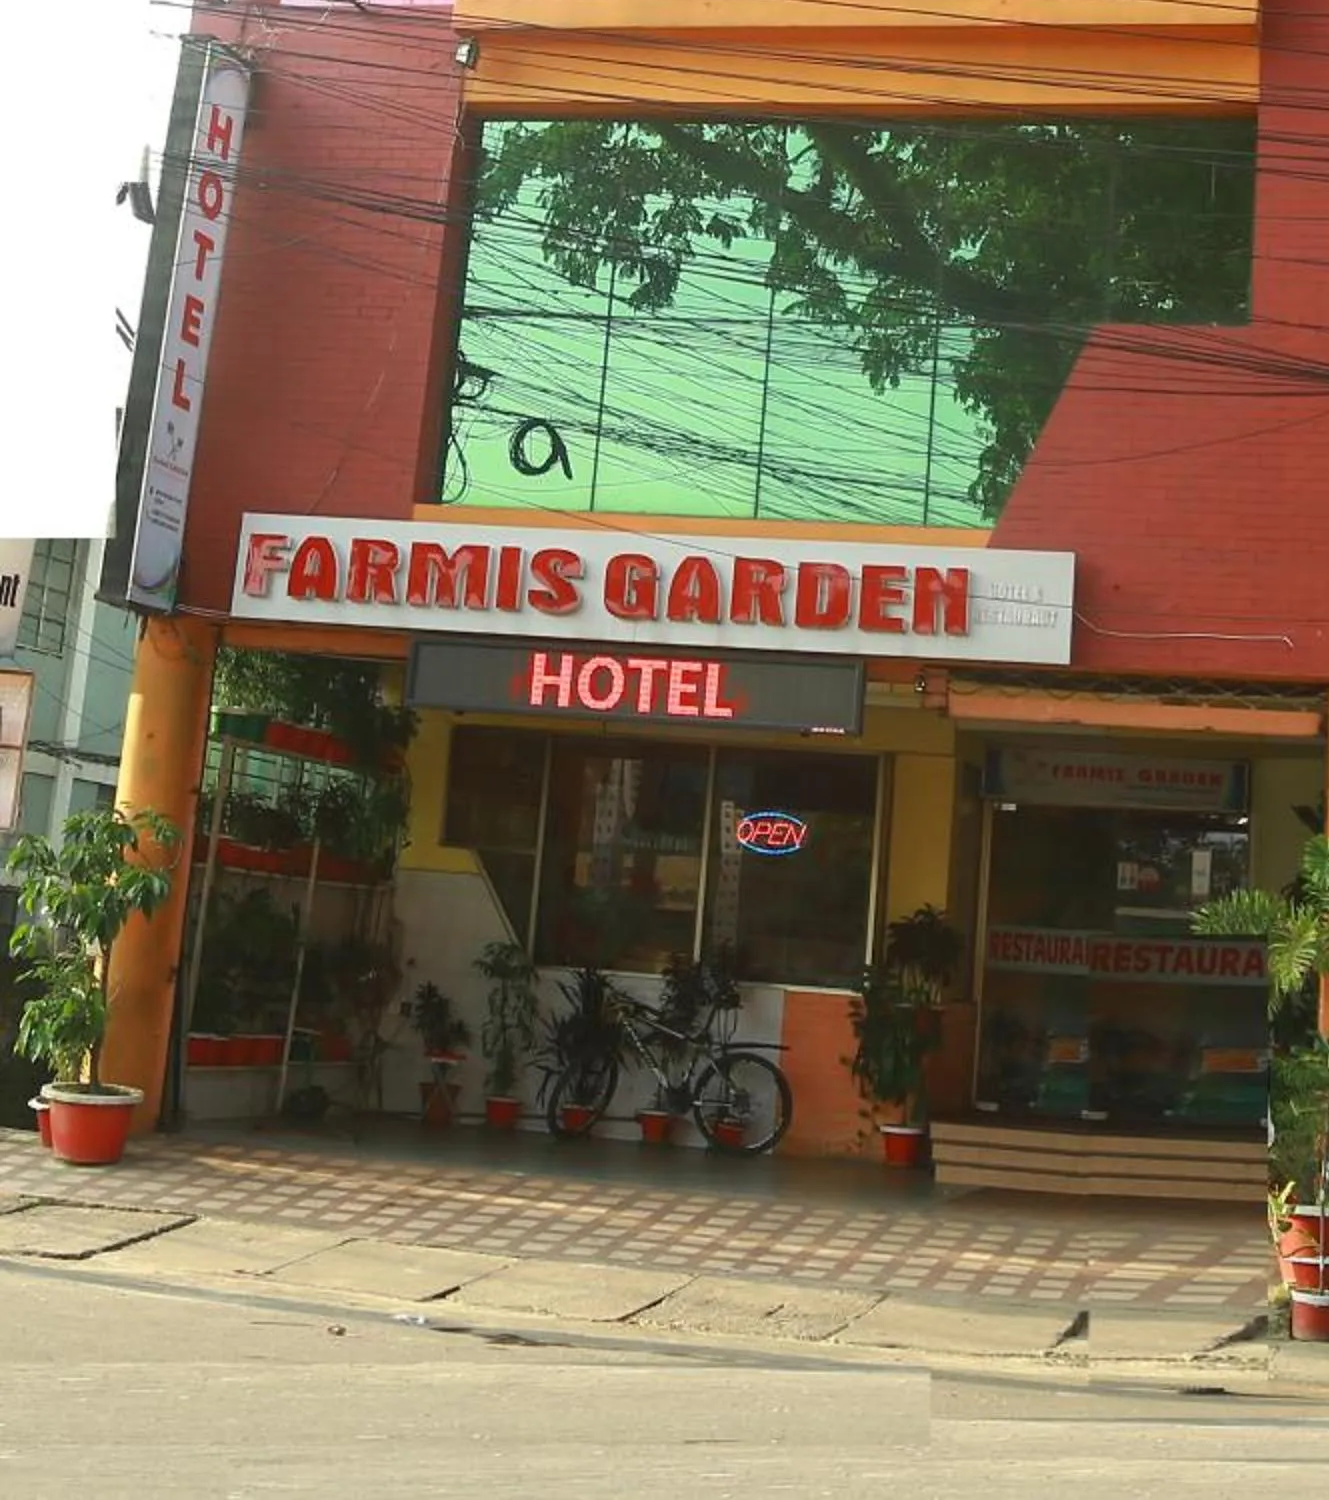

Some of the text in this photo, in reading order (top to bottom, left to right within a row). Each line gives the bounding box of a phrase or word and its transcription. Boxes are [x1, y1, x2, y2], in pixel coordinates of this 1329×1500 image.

[172, 103, 233, 412] HOTEL
[241, 533, 971, 637] FARMIS GARDEN
[529, 652, 733, 718] HOTEL
[737, 821, 807, 849] OPEN
